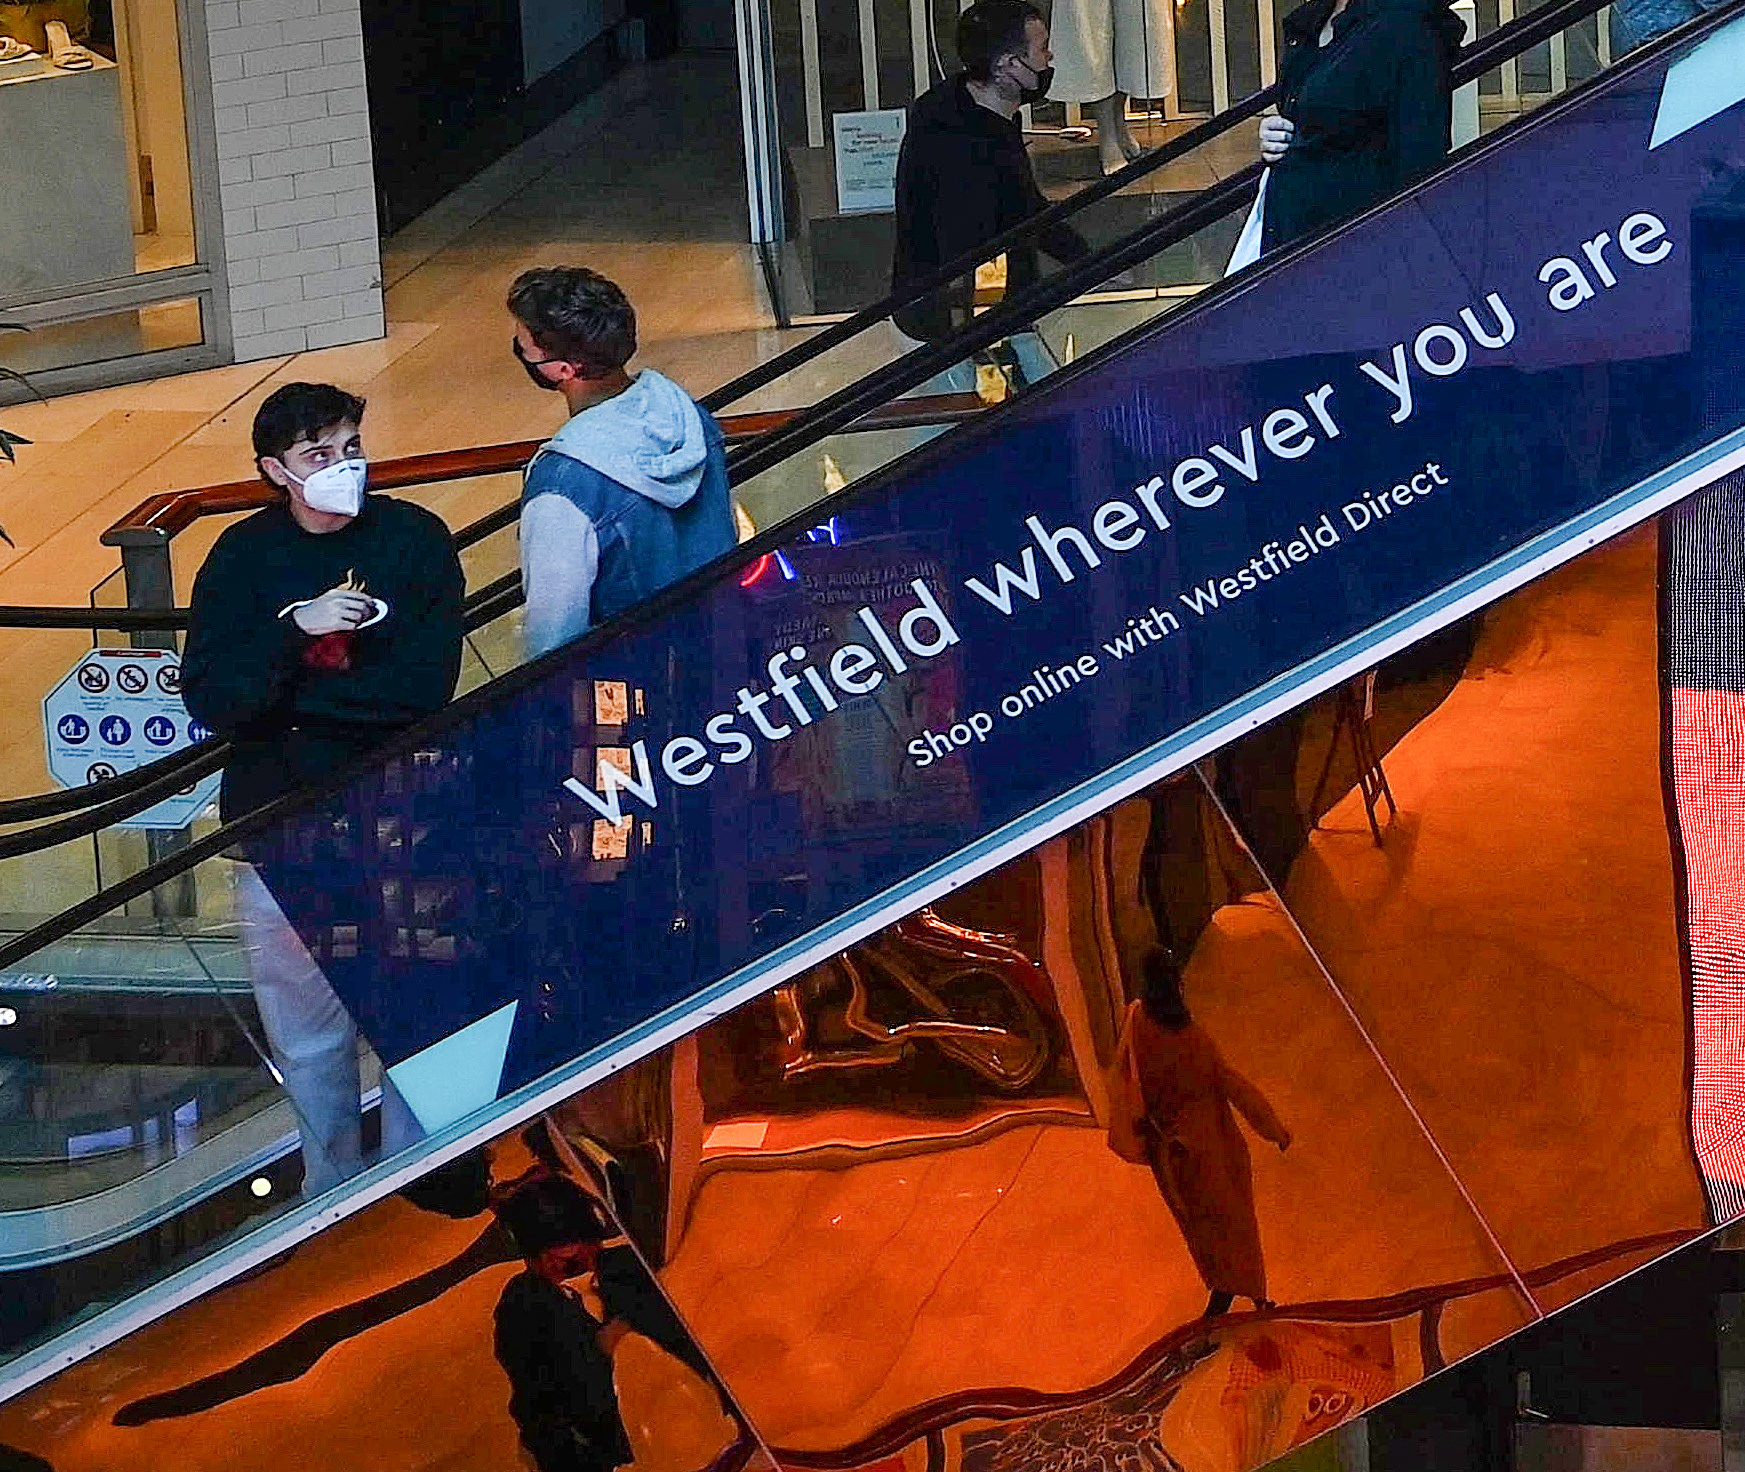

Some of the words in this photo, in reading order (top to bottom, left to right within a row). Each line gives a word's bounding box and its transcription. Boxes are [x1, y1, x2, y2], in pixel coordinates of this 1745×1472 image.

[562, 578, 961, 833] Westfield
[964, 383, 1341, 615] wherever
[1359, 292, 1516, 424] you
[1537, 212, 1674, 312] are
[907, 711, 994, 768] Shop
[1000, 654, 1100, 718] online
[1101, 606, 1181, 661] with
[1178, 513, 1342, 617] Westfield
[1341, 461, 1450, 533] Direct
